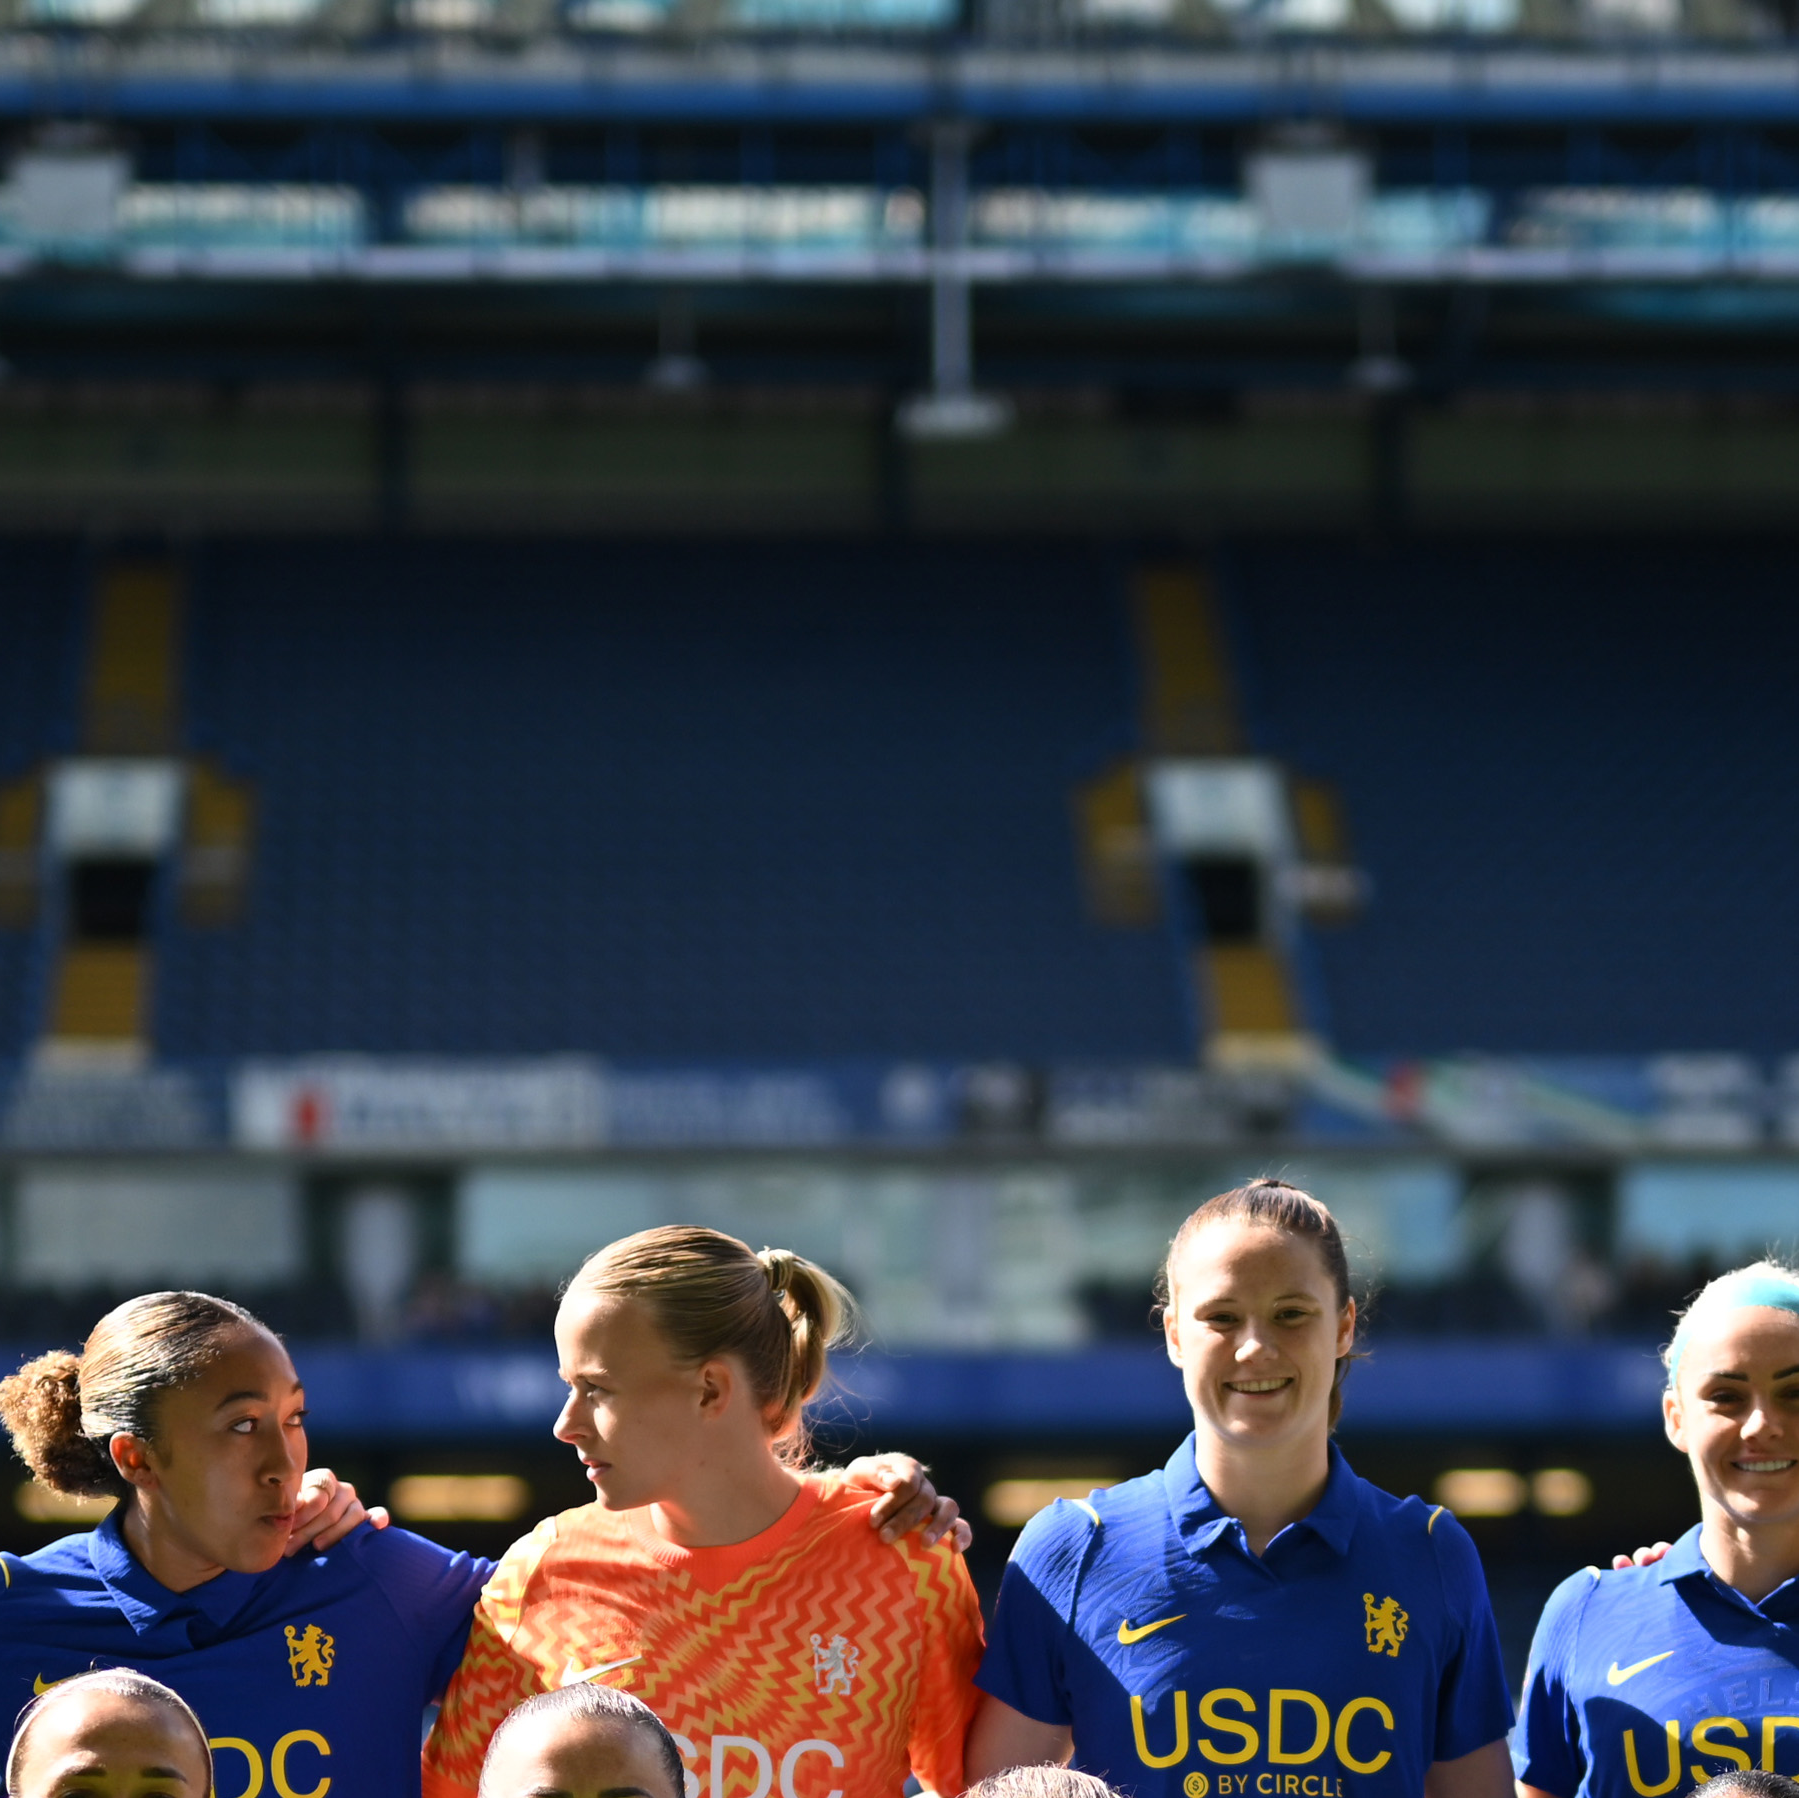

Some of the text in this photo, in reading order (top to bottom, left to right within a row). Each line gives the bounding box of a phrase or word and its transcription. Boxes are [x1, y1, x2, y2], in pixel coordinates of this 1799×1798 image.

[1130, 1687, 1395, 1775] USDC
[1218, 1773, 1343, 1798] BY CIRCLE
